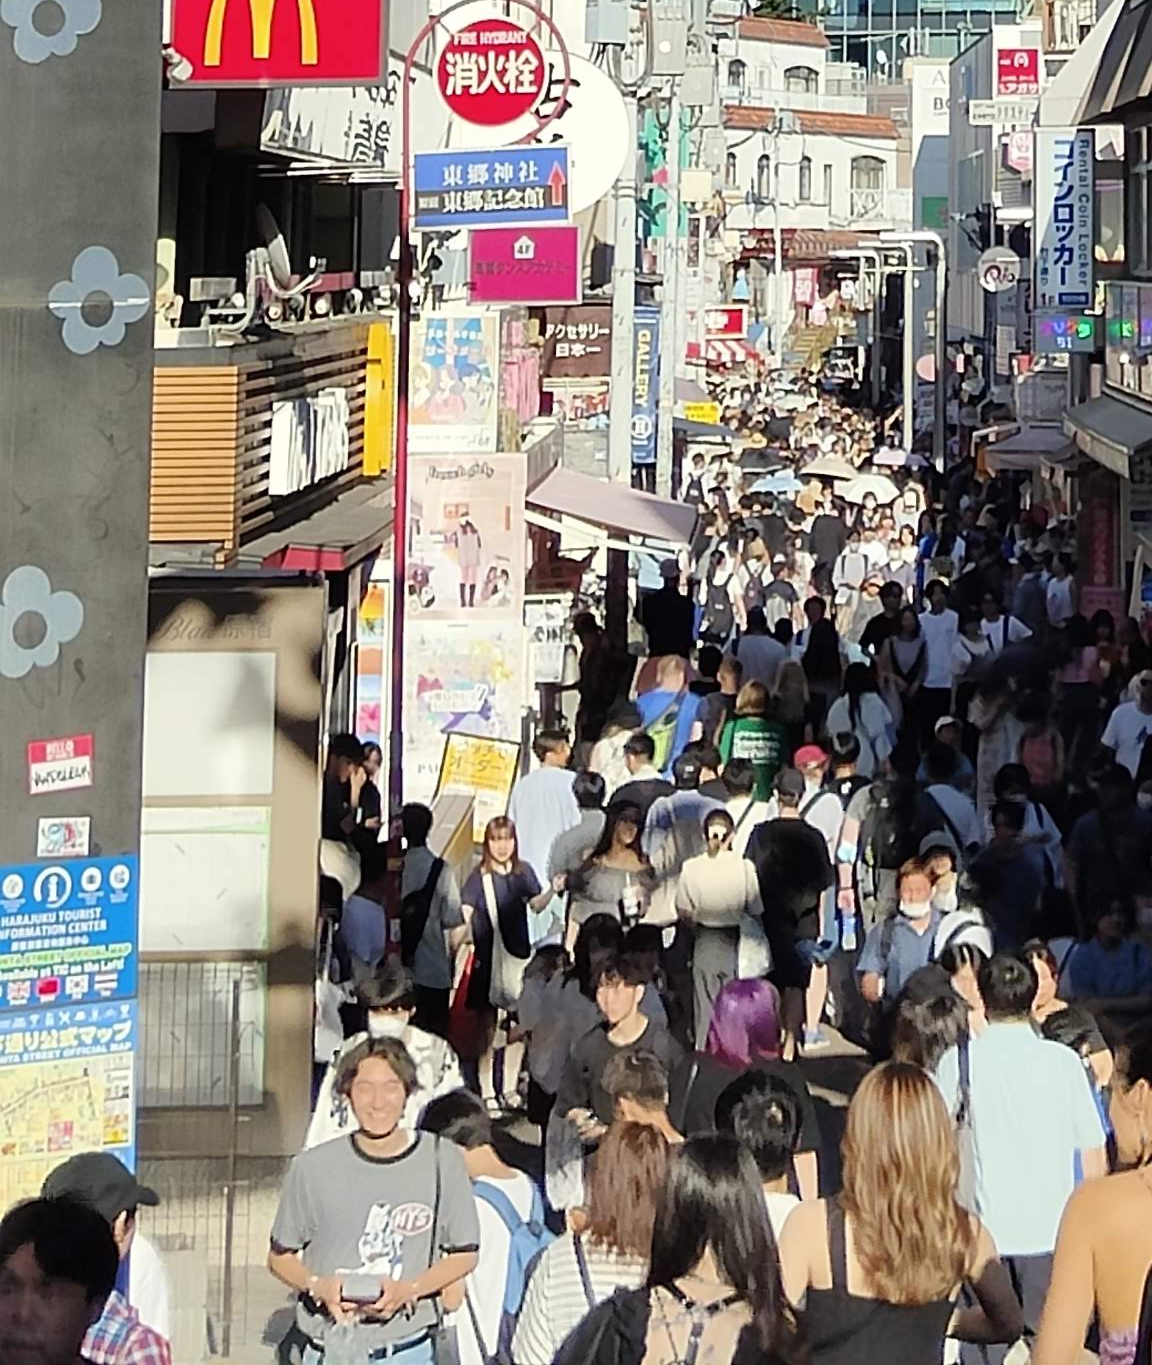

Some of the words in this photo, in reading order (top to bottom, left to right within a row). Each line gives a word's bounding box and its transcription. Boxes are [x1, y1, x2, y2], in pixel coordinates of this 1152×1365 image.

[445, 48, 539, 96] 消火栓
[441, 159, 540, 188] 東郷神社
[1078, 138, 1090, 184] Rental
[441, 185, 546, 214] 東郷記念館
[1053, 138, 1075, 286] コインロッカー
[1078, 192, 1090, 229] Coin
[1078, 233, 1090, 286] Locker
[545, 322, 610, 340] アクセサリー
[555, 342, 602, 359] 日本一
[635, 328, 651, 408] GALLERY
[1, 911, 57, 927] HARAJUKU
[58, 908, 102, 922] TOURIST
[68, 919, 108, 934] CENTER
